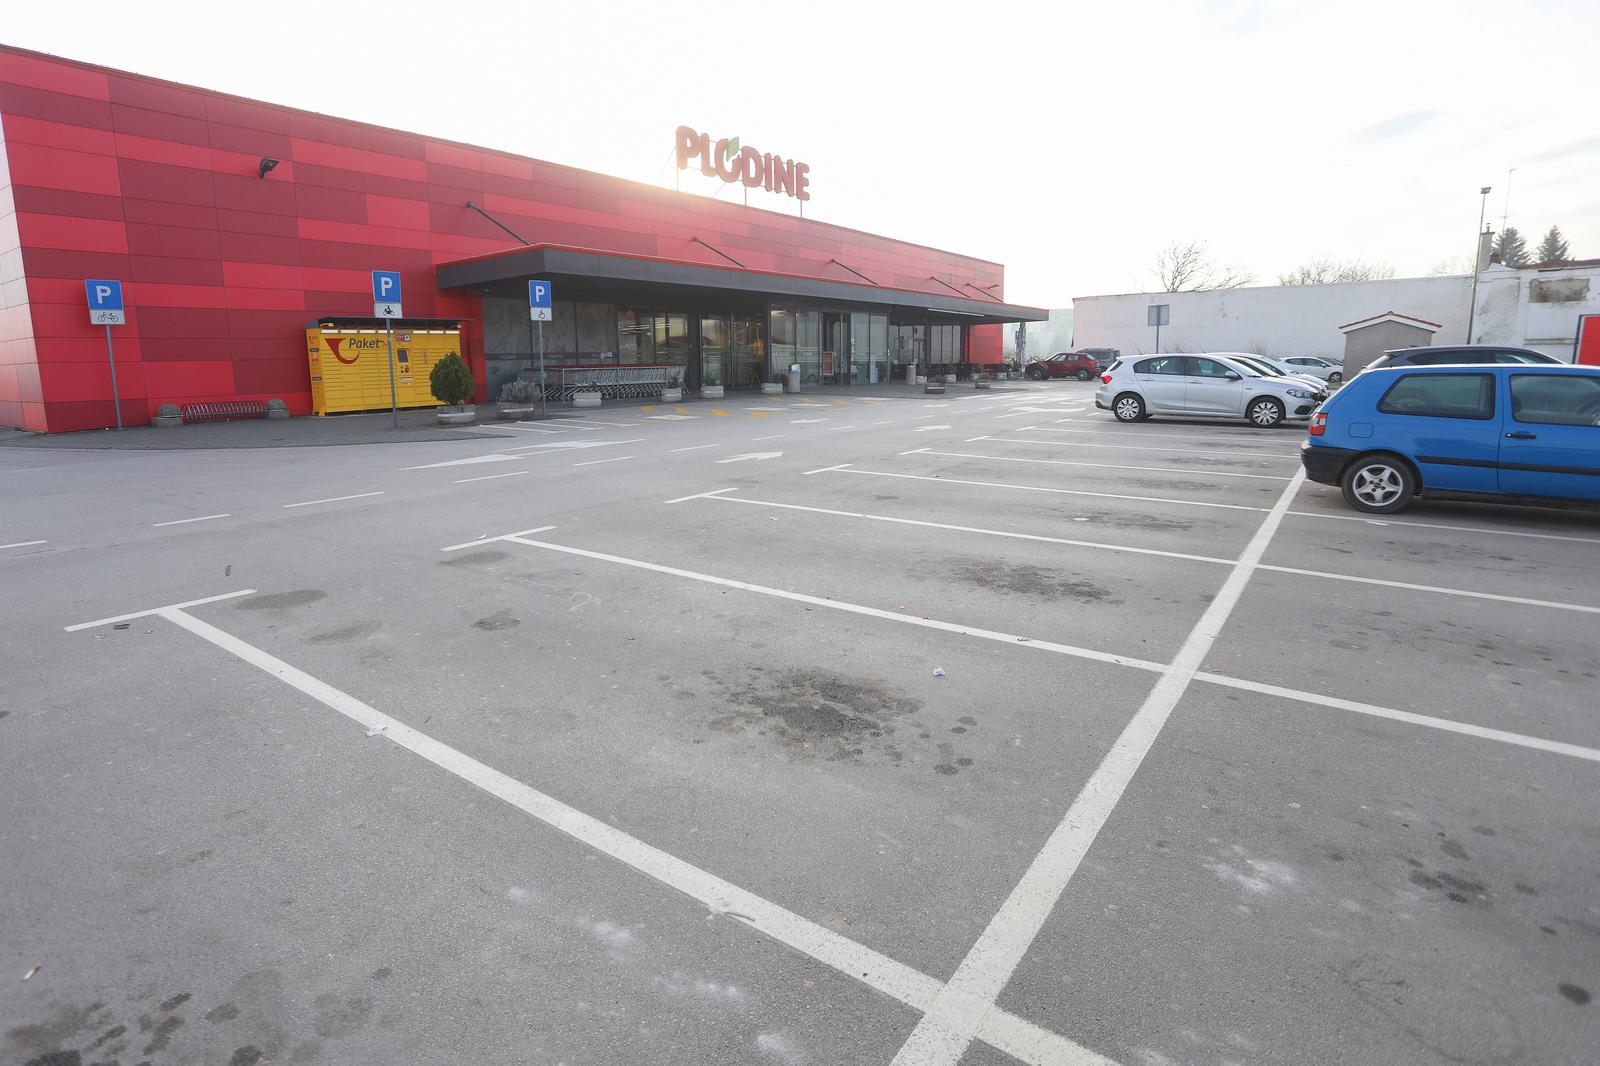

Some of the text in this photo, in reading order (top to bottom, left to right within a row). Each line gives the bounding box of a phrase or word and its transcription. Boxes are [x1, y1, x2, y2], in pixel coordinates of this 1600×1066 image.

[676, 125, 811, 201] PLODINE
[97, 286, 111, 303] P
[381, 277, 392, 296] P
[536, 286, 545, 302] P
